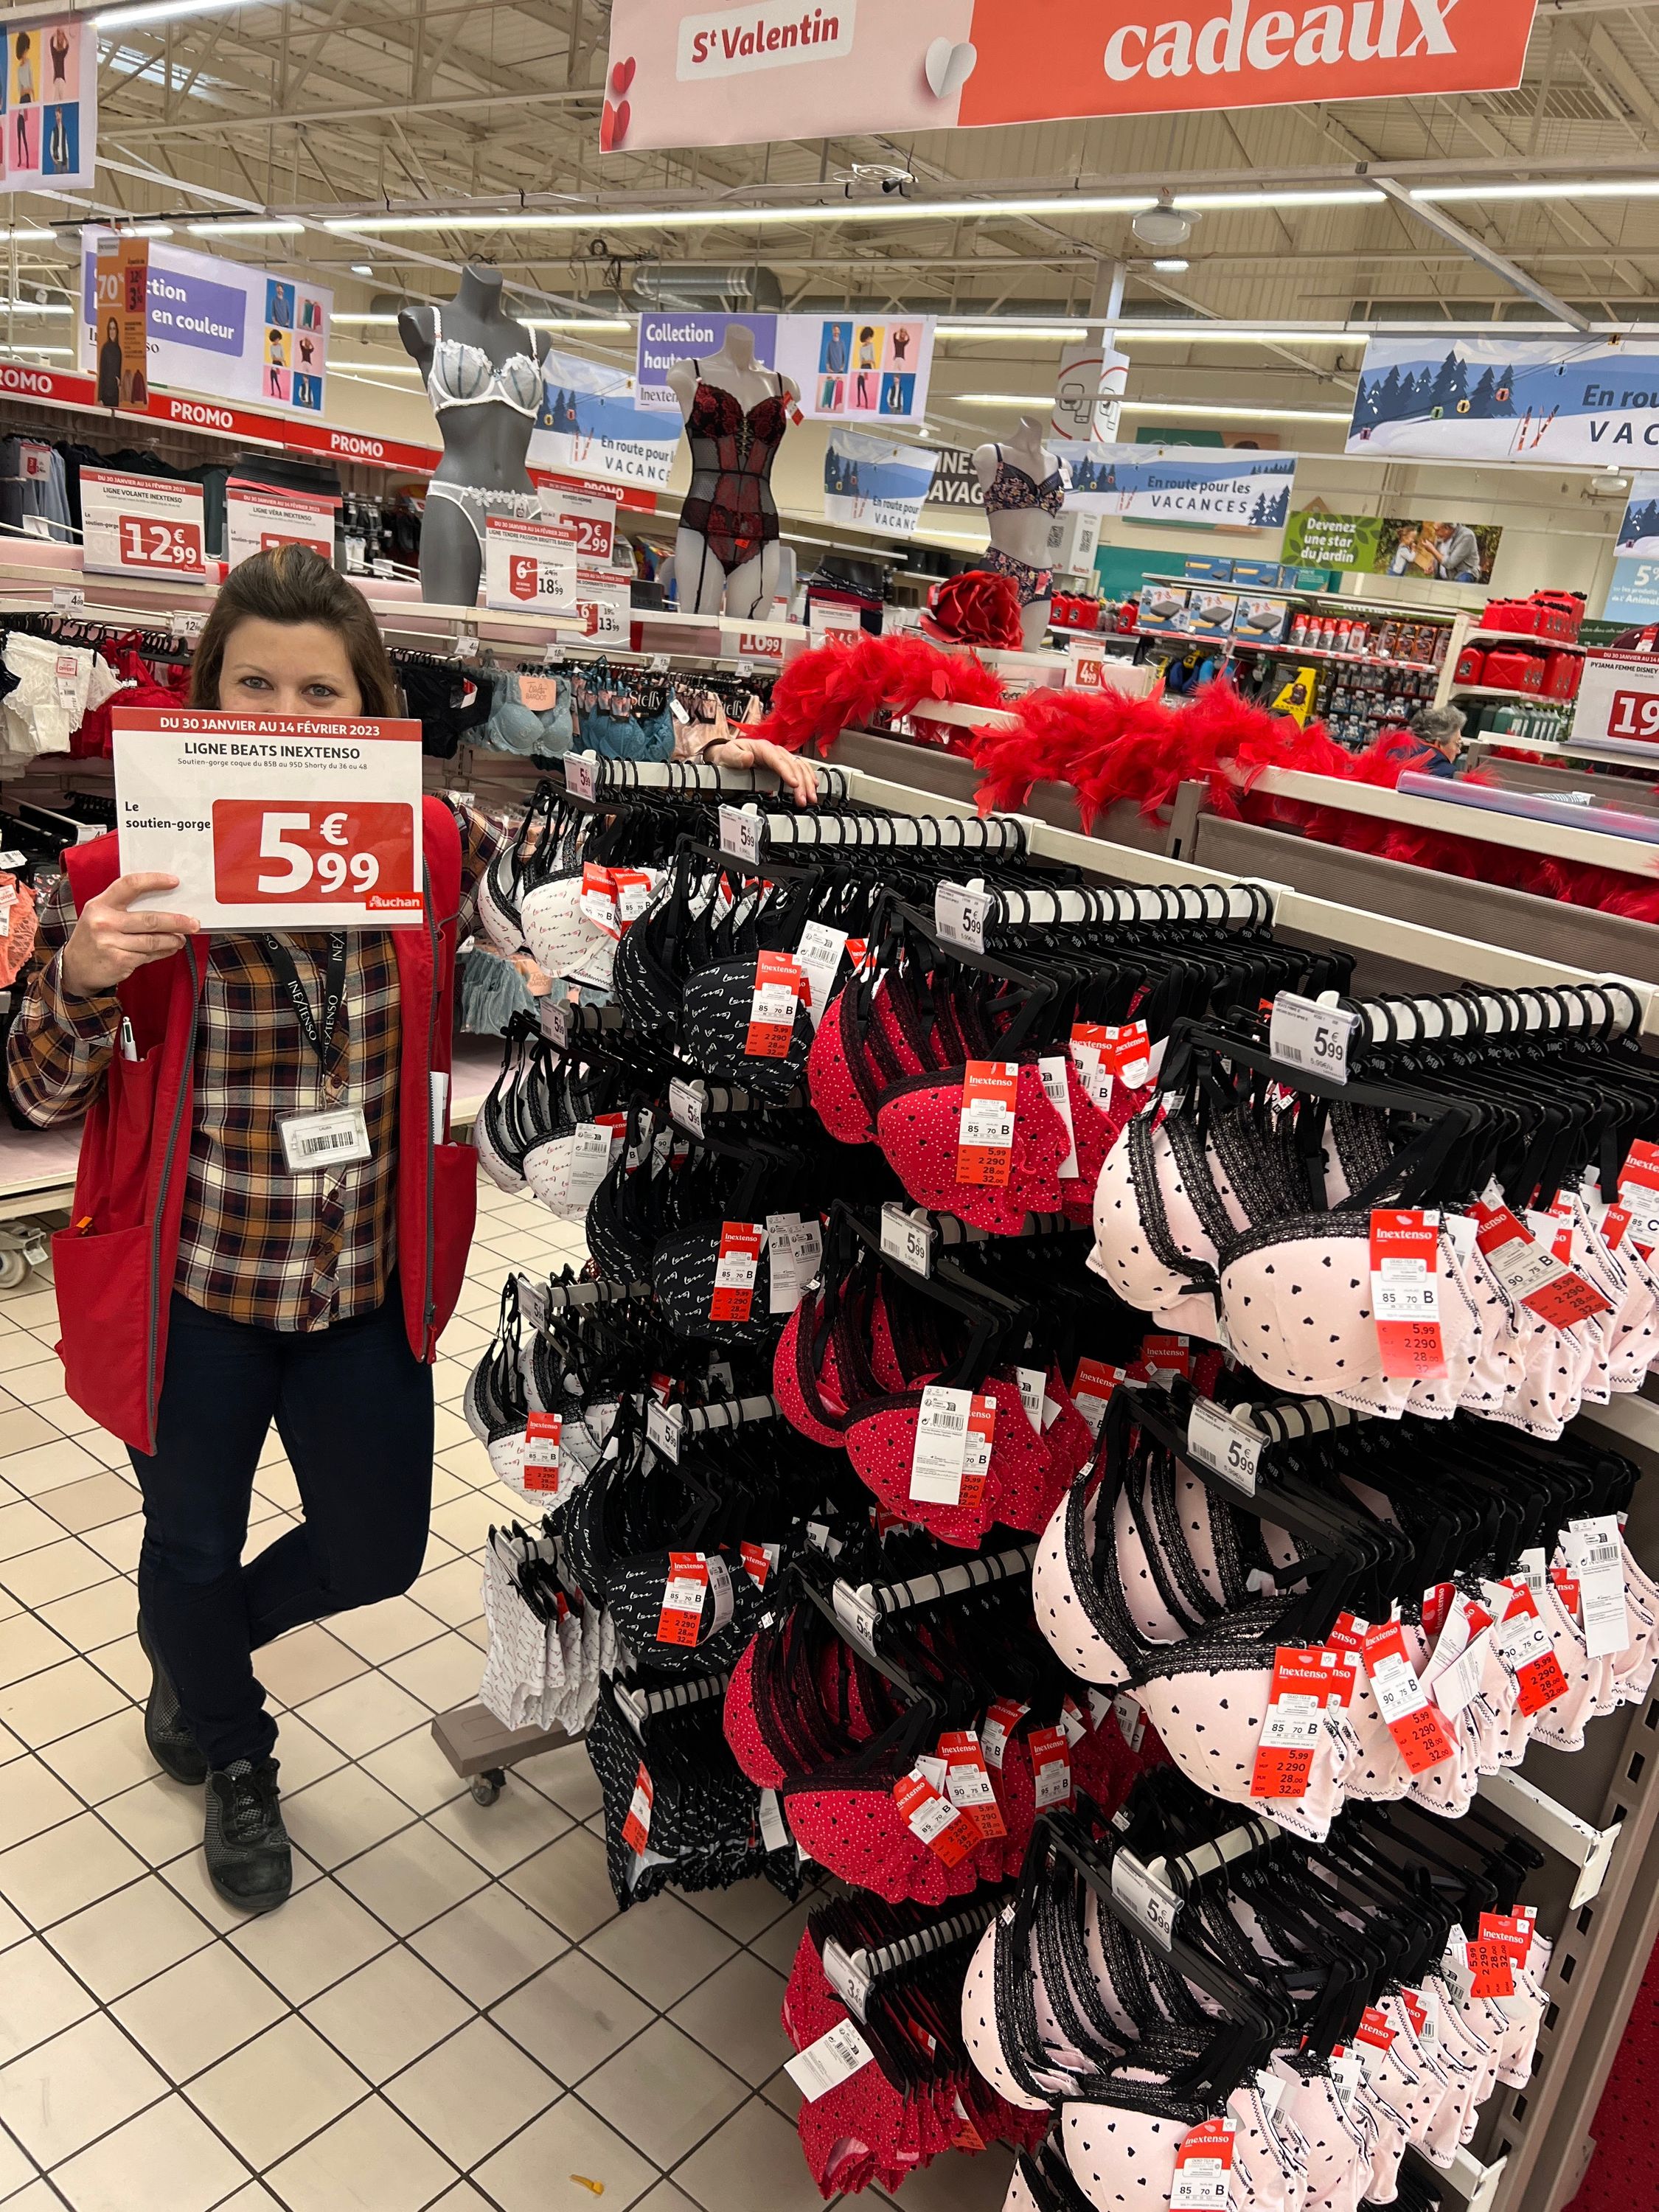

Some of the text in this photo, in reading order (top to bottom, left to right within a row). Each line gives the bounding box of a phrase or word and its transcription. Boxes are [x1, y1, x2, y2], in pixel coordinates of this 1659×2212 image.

[722, 9, 839, 59] Valentin
[1104, 0, 1458, 81] cadeaux
[152, 309, 234, 340] en couleur
[646, 322, 714, 343] Collection
[1582, 384, 1614, 406] En
[170, 400, 233, 428] PROMO
[331, 434, 383, 457] PROMO
[601, 435, 669, 462] En route pour
[936, 451, 977, 475] INE
[114, 477, 136, 486] JANVIER
[1148, 476, 1251, 495] En route pour les
[102, 487, 121, 495] LIGNE
[121, 489, 149, 498] VOLANTE
[150, 494, 182, 504] INEXTENSO
[873, 495, 882, 507] En
[883, 498, 902, 510] route
[1151, 495, 1248, 513] VACANCES
[283, 512, 312, 521] INEXTENSO
[86, 520, 119, 530] soutien-gorge
[1307, 518, 1357, 533] Devenez
[1304, 535, 1352, 548] une star
[1301, 546, 1354, 563] du jardin
[1590, 661, 1614, 669] PYJAMA
[630, 690, 663, 711] Steffy
[160, 717, 380, 736] DU 30 JANVIER AU 14 FÉVRIER 2023
[184, 742, 361, 759] LIGNE BEATS INEXTENSO
[178, 758, 229, 768] Soutien-gorge
[305, 762, 327, 771] Shorty
[125, 801, 139, 812] Le
[126, 817, 211, 831] soutien-gorge
[369, 894, 420, 908] Auchan
[762, 963, 798, 975] Inextenso
[786, 1006, 793, 1015] B
[969, 1076, 1012, 1086] Inextenso
[1099, 1088, 1107, 1098] B
[1001, 1124, 1009, 1135] B
[1648, 1220, 1659, 1231] C
[725, 1234, 758, 1242] Inextenso
[1377, 1228, 1433, 1239] Inextenso
[1508, 1255, 1554, 1286] 90 75 B
[1382, 1293, 1396, 1302] 85
[1424, 1290, 1433, 1304] B
[1147, 1348, 1184, 1357] Inextenso
[978, 1455, 987, 1464] B
[695, 1594, 702, 1602] B
[1366, 1627, 1398, 1646] Inextenso
[1534, 1630, 1544, 1641] C
[1279, 1665, 1327, 1680] Inextenso
[1383, 1679, 1418, 1704] 90 75 B
[1272, 1723, 1284, 1732] 85
[1307, 1723, 1318, 1734] B
[942, 1745, 977, 1754] Inextenso
[1034, 1740, 1064, 1753] Inextenso
[981, 1783, 990, 1792] B
[1041, 1778, 1068, 1795] 95 B
[922, 1805, 951, 1834] 85 70 B
[1483, 1928, 1524, 1944] Inextenso
[1185, 2135, 1229, 2146] Inextenso
[1180, 2186, 1192, 2194] 85
[1215, 2184, 1225, 2196] B
